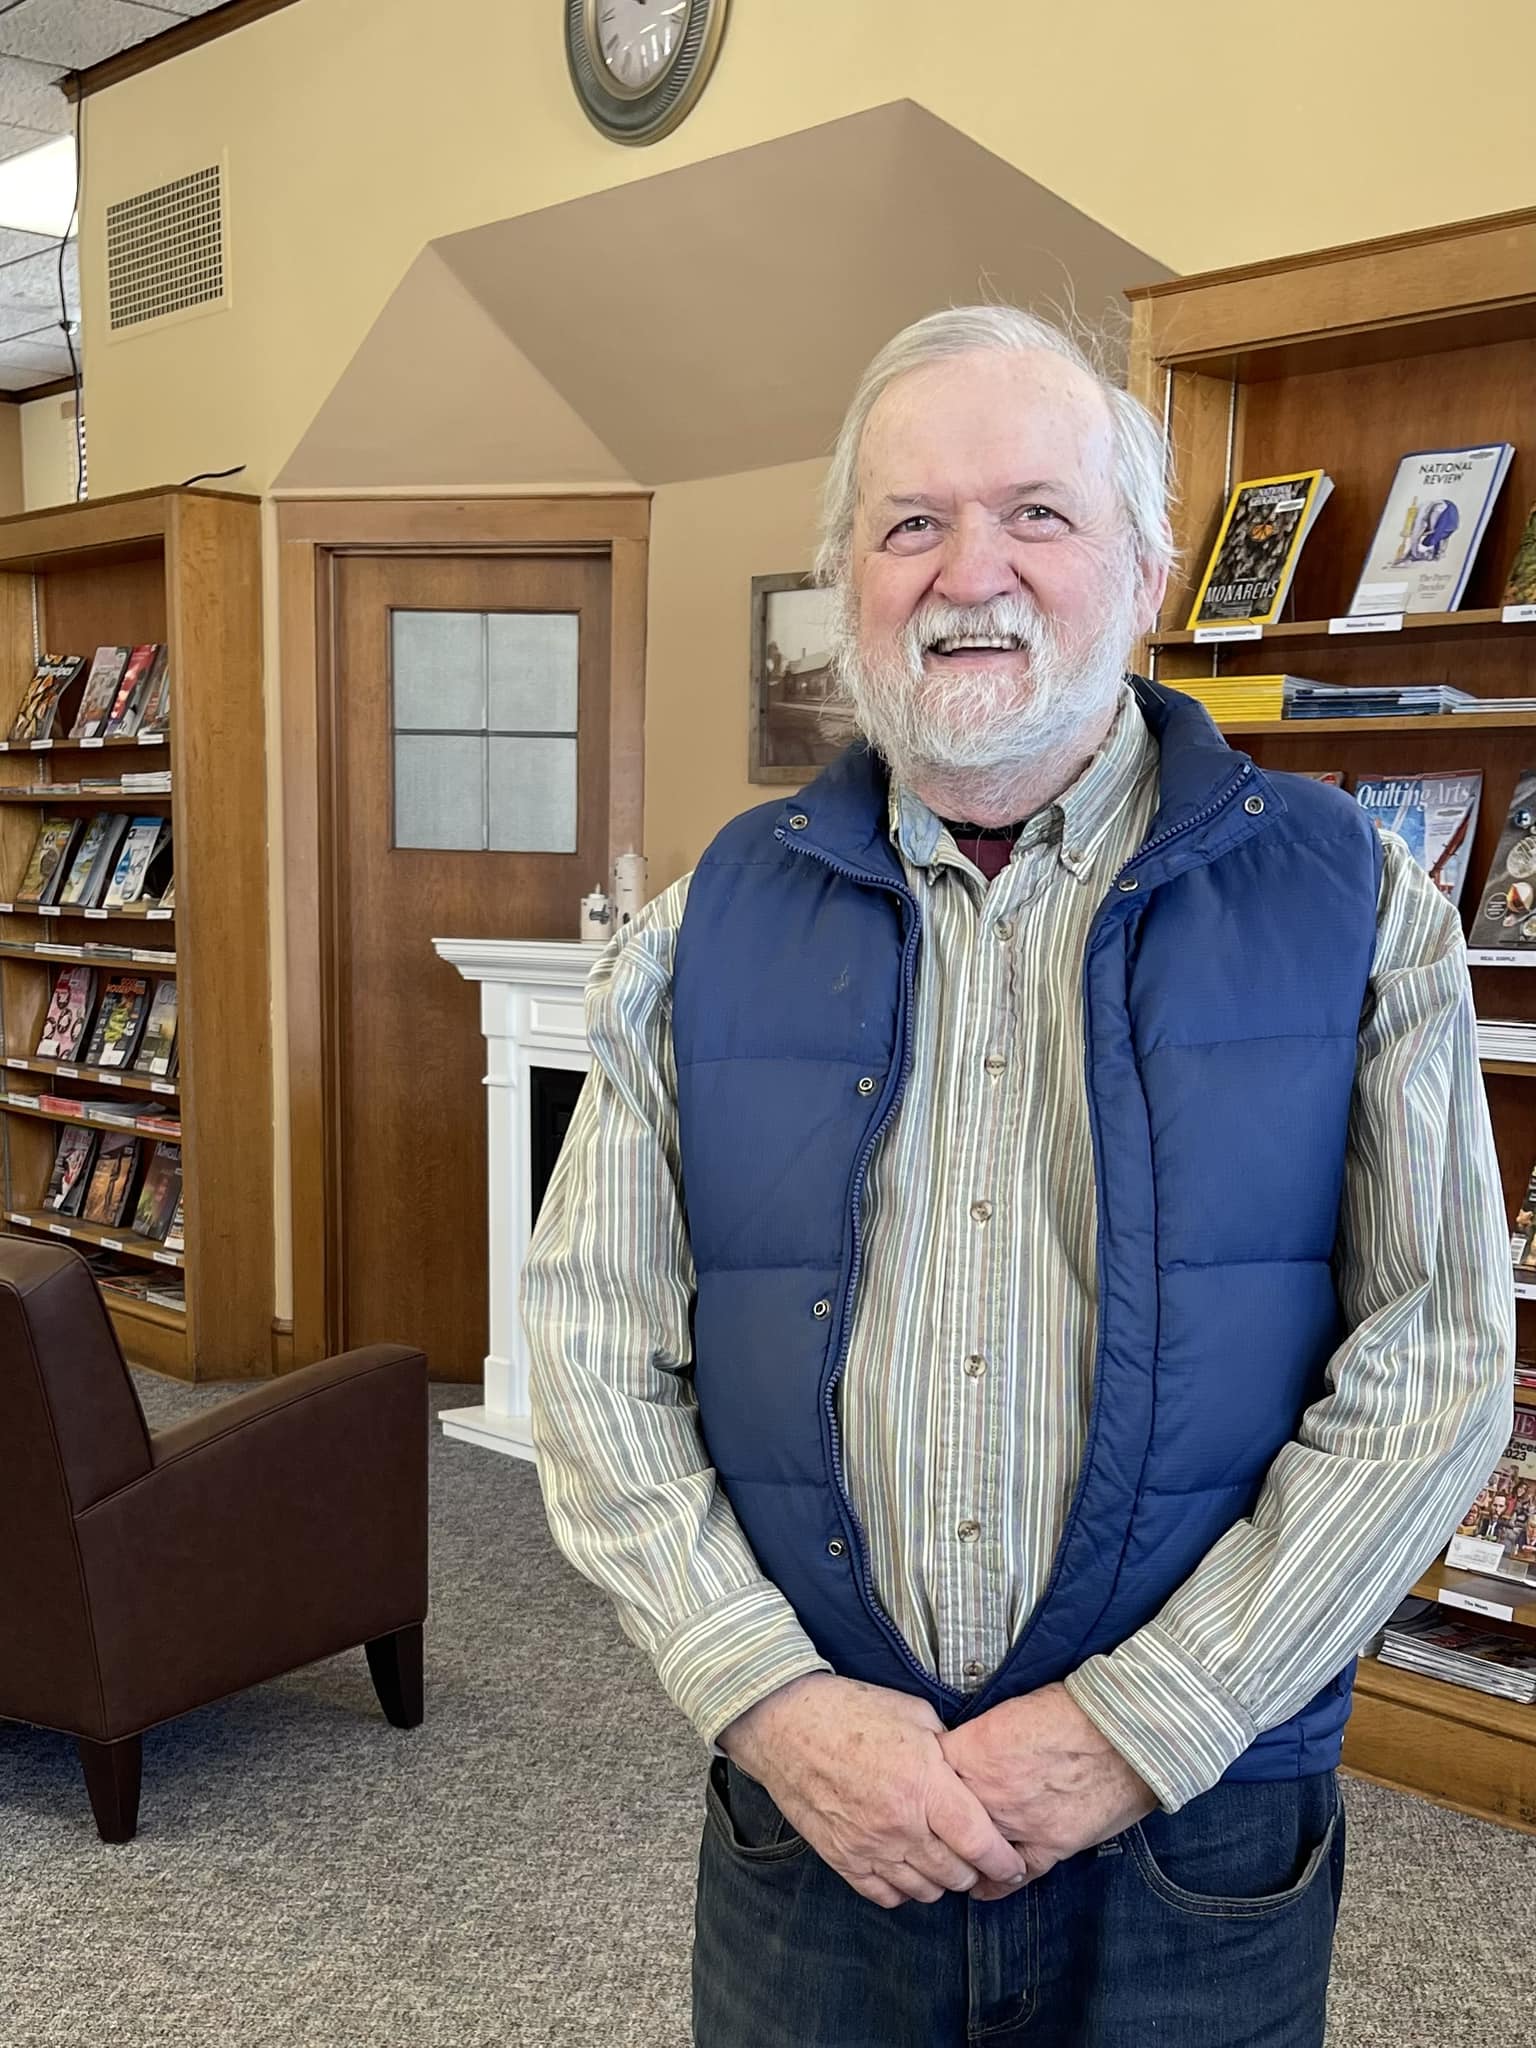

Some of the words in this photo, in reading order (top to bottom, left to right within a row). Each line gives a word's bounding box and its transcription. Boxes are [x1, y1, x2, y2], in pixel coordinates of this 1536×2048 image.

[1419, 462, 1473, 474] NATIONAL
[1423, 472, 1464, 485] REVIEW
[1205, 580, 1278, 603] MONARCHS
[1357, 781, 1430, 812] Quilting
[1438, 782, 1470, 804] Arts
[1501, 1448, 1527, 1461] 023
